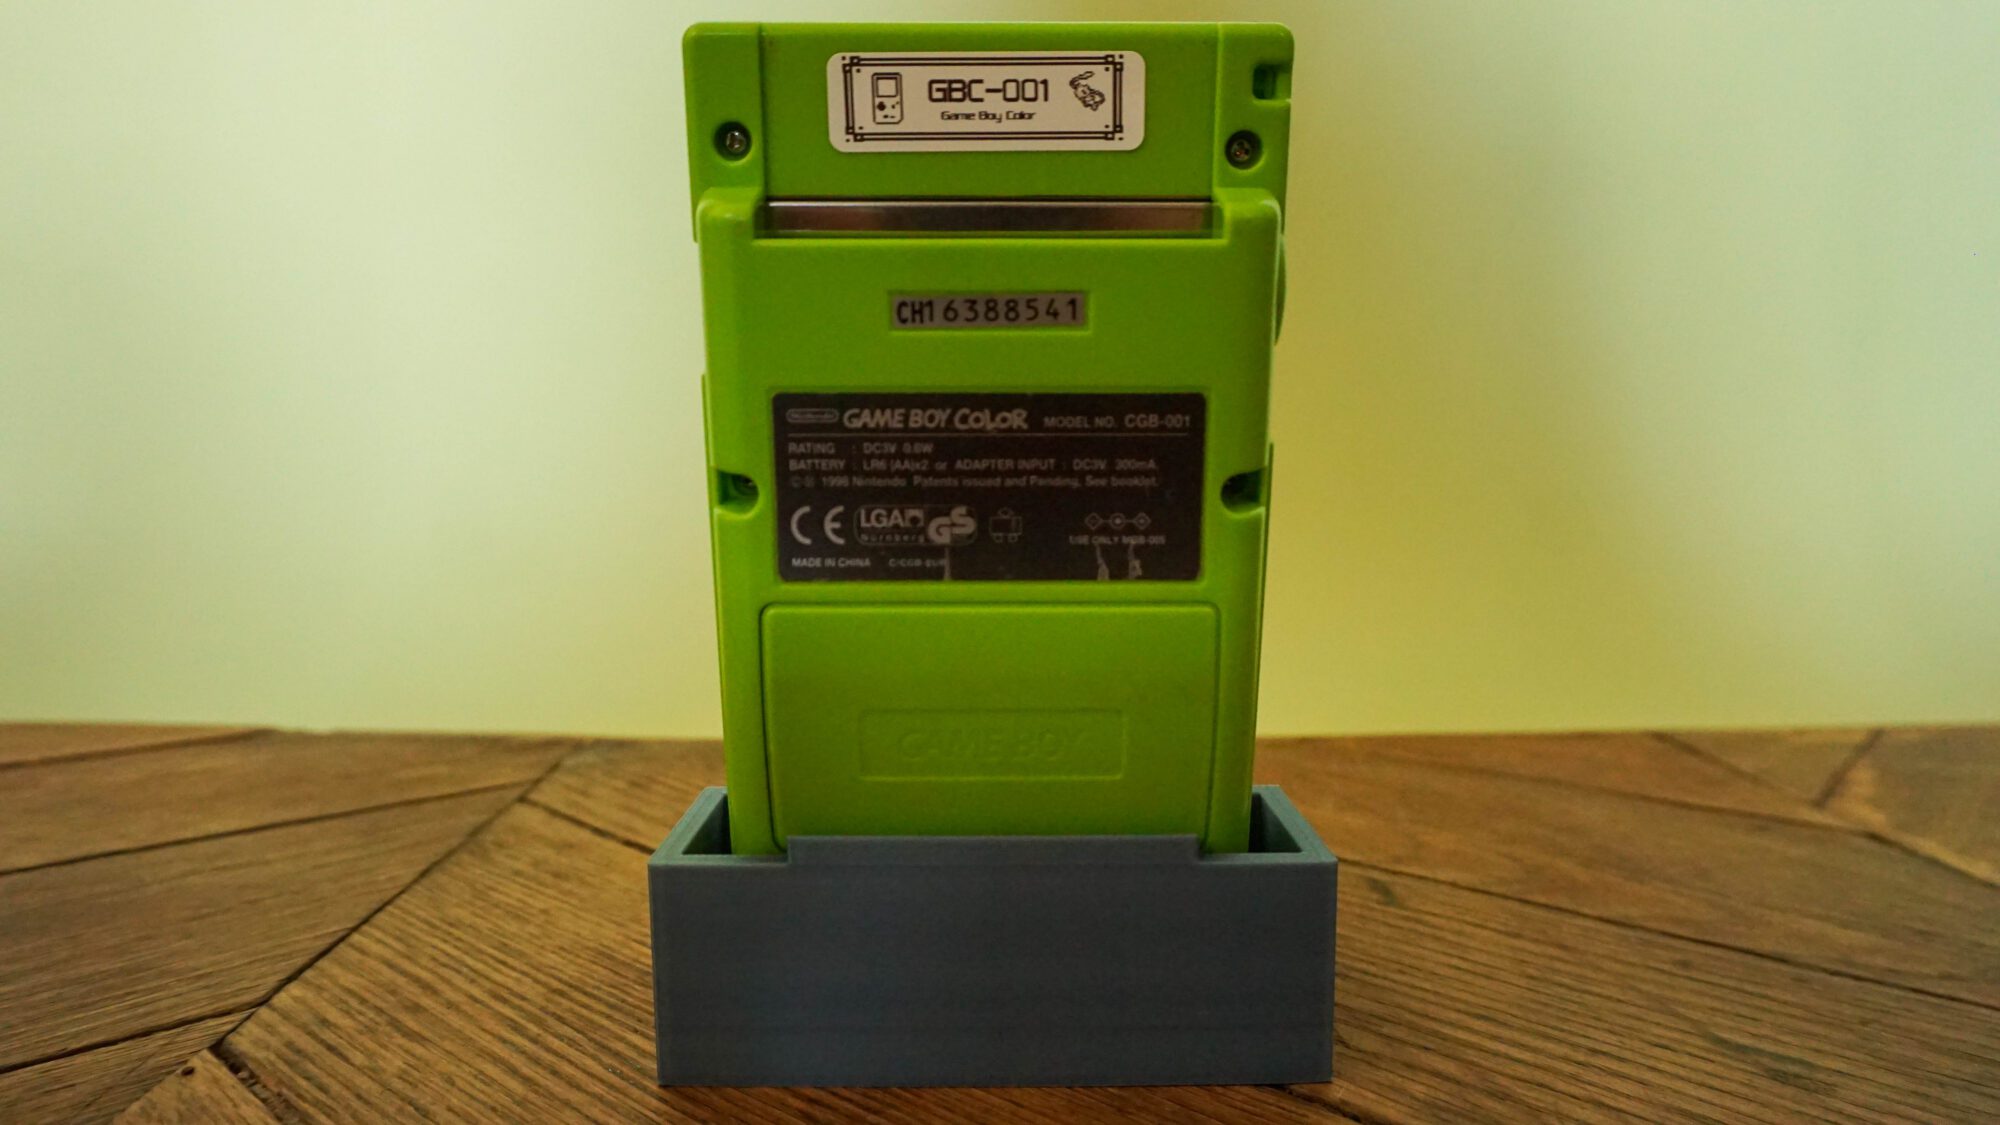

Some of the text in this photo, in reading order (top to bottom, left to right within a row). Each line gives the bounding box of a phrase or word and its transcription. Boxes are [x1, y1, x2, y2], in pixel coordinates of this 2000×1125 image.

[928, 78, 1049, 103] GBC-001
[940, 110, 1037, 123] Game Boy Color
[843, 408, 905, 429] GAME
[909, 408, 952, 429] BOY
[1043, 416, 1091, 428] MODEL
[1124, 414, 1191, 429] CGB-001
[788, 442, 835, 455] RATING
[863, 442, 897, 455] DC3V
[789, 459, 846, 471] BATTERY
[955, 458, 1014, 471] ADAPTER
[1018, 458, 1056, 471] INPUT
[790, 505, 845, 545] CE
[859, 508, 904, 528] LGA
[928, 505, 978, 544] GS
[791, 557, 822, 568] MADE
[824, 557, 836, 568] IN
[838, 557, 871, 568] CHINA
